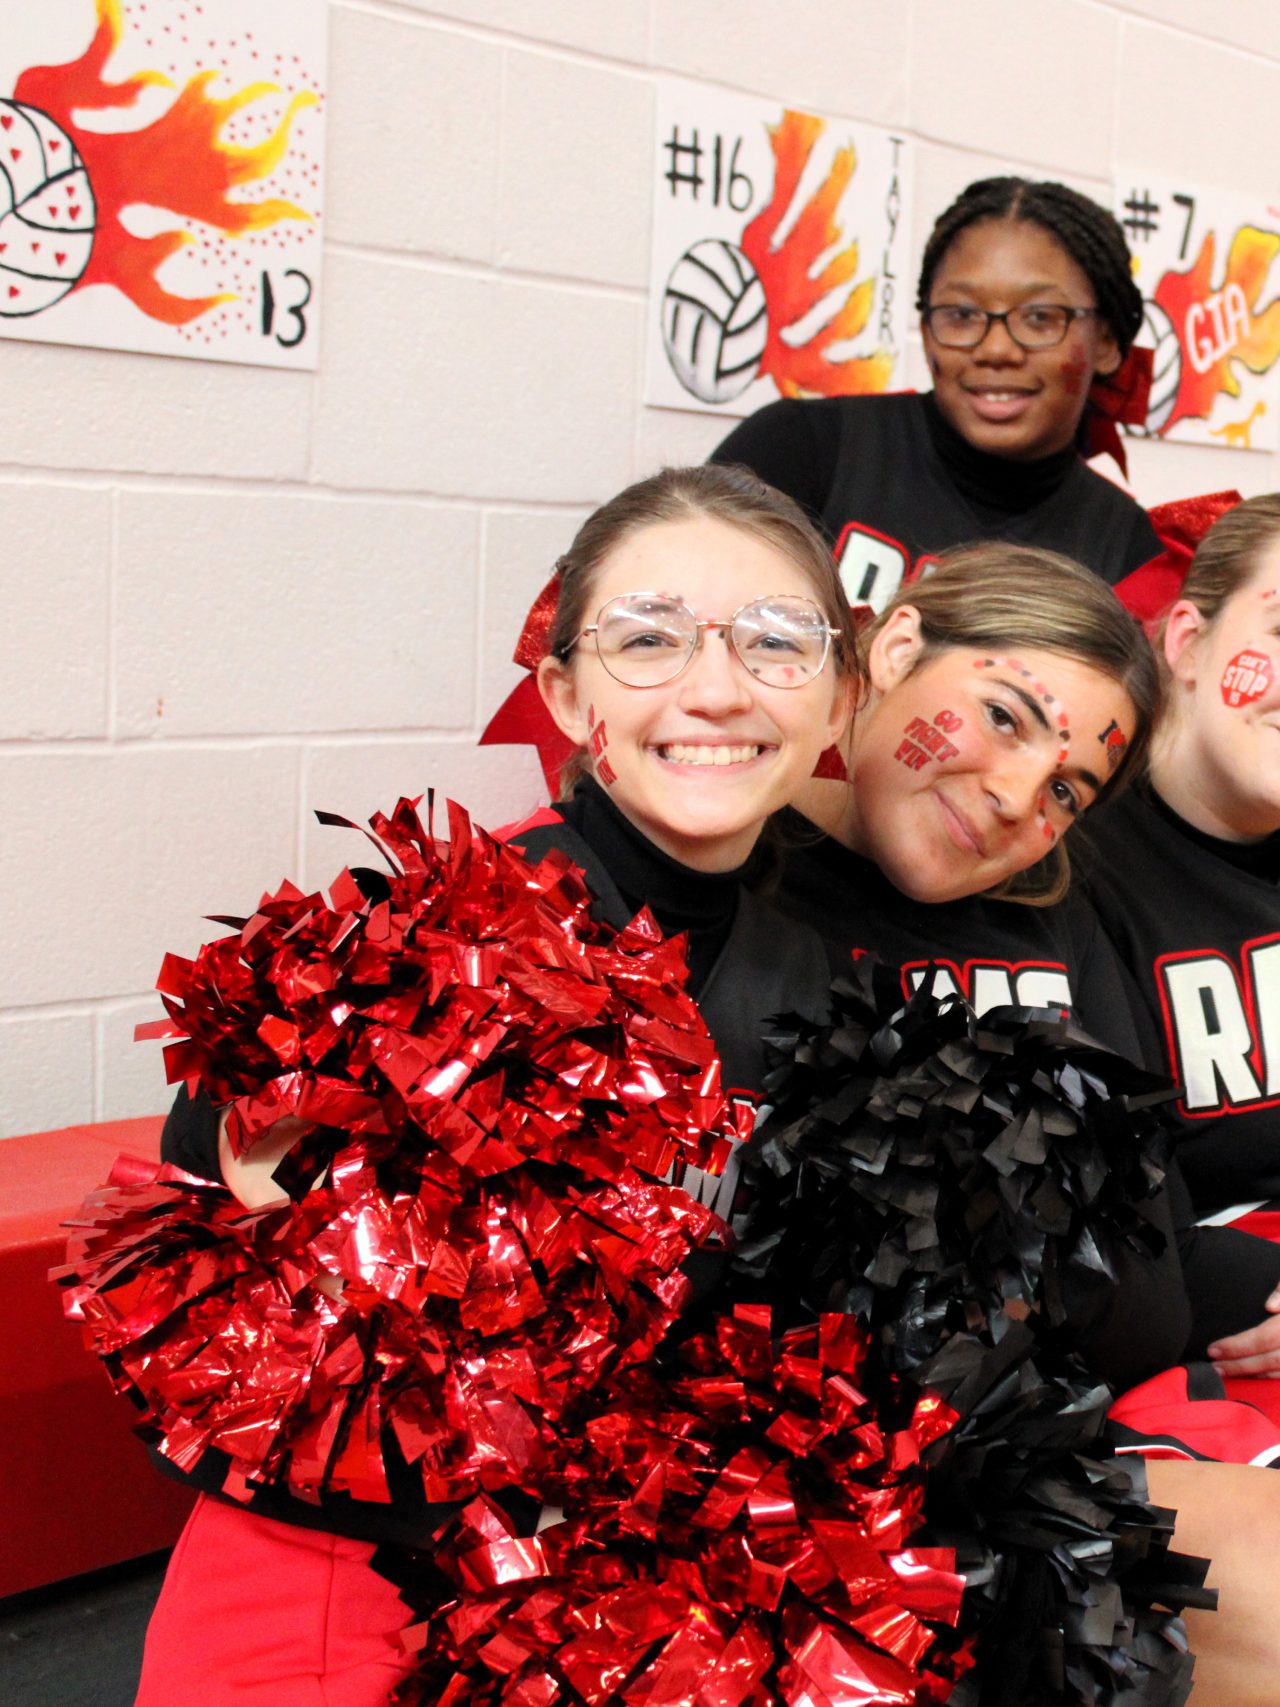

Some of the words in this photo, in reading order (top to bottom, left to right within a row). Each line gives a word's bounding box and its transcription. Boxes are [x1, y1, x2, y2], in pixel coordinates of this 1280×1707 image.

[663, 125, 753, 213] #16
[877, 135, 906, 344] TAYLOR
[261, 268, 312, 348] 13
[1186, 282, 1250, 374] GIA
[1223, 665, 1269, 697] STOP
[903, 716, 961, 763] FIGHT
[933, 709, 964, 734] GO
[893, 738, 933, 771] WIN
